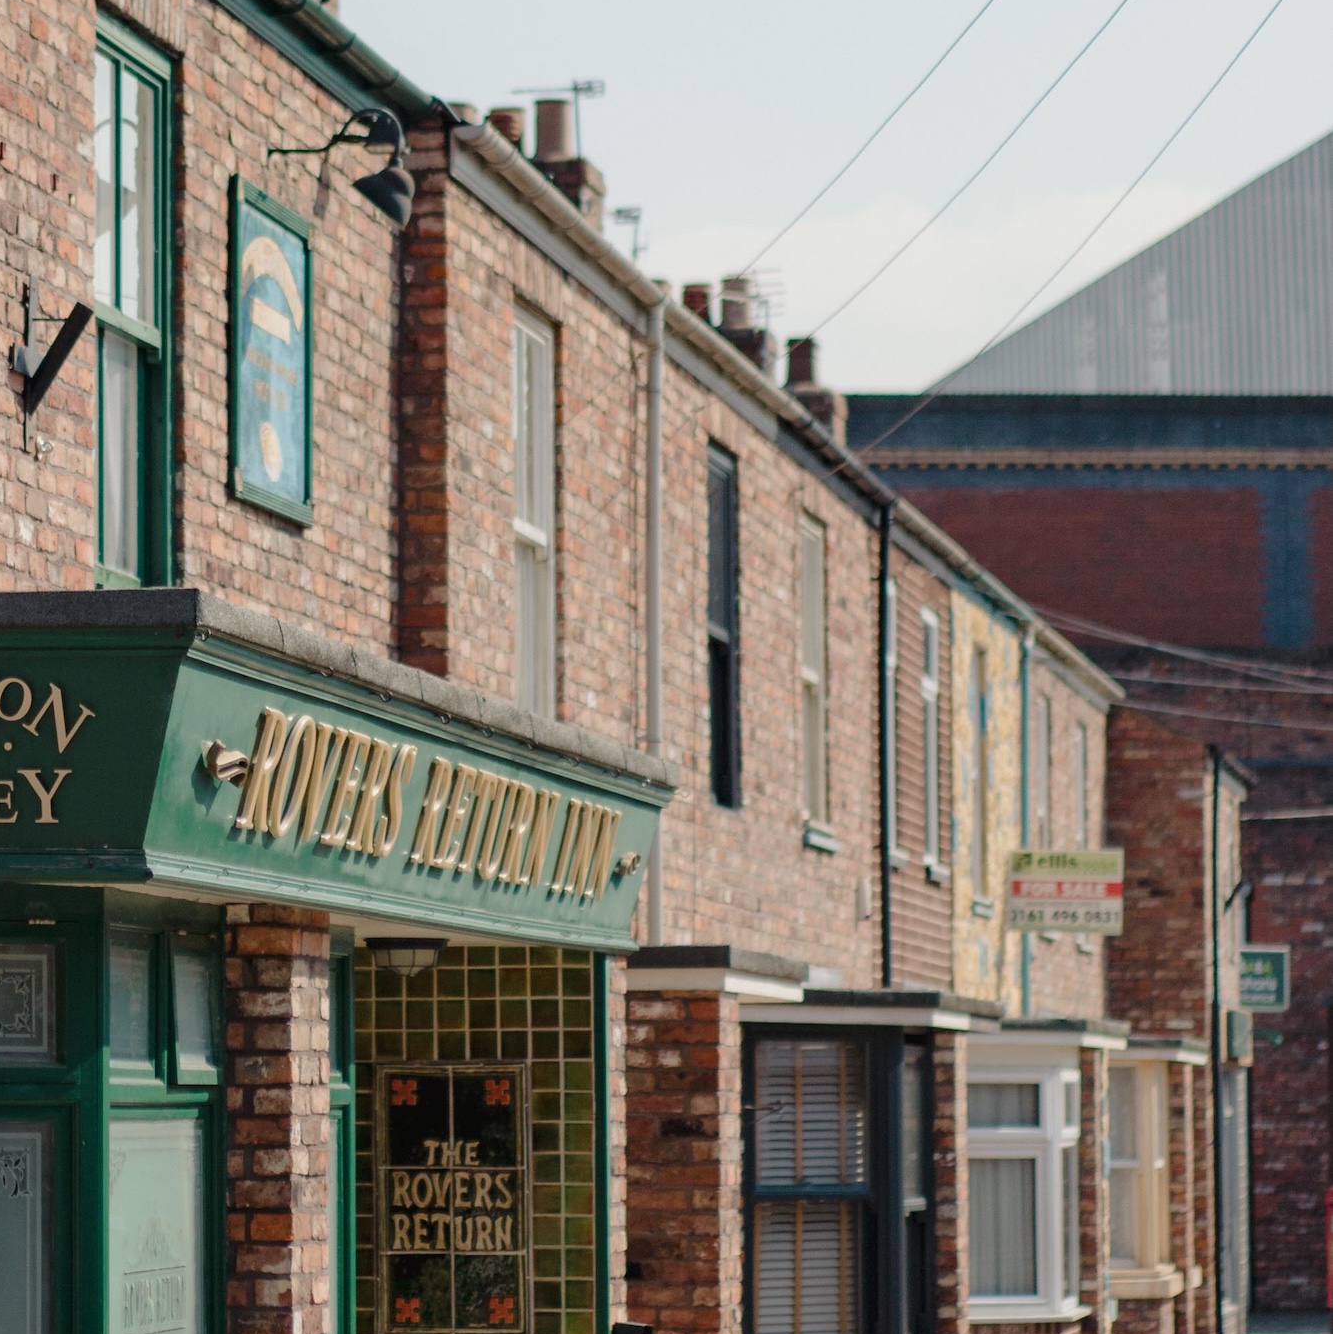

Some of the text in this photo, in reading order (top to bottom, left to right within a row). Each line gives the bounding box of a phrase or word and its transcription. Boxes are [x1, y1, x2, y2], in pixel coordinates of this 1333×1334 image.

[236, 707, 623, 902] ROVERS RETURN INN
[1020, 882, 1106, 899] FOR SALE
[423, 1140, 481, 1166] THE
[392, 1171, 514, 1210] ROVERS
[392, 1214, 514, 1251] RETURN
